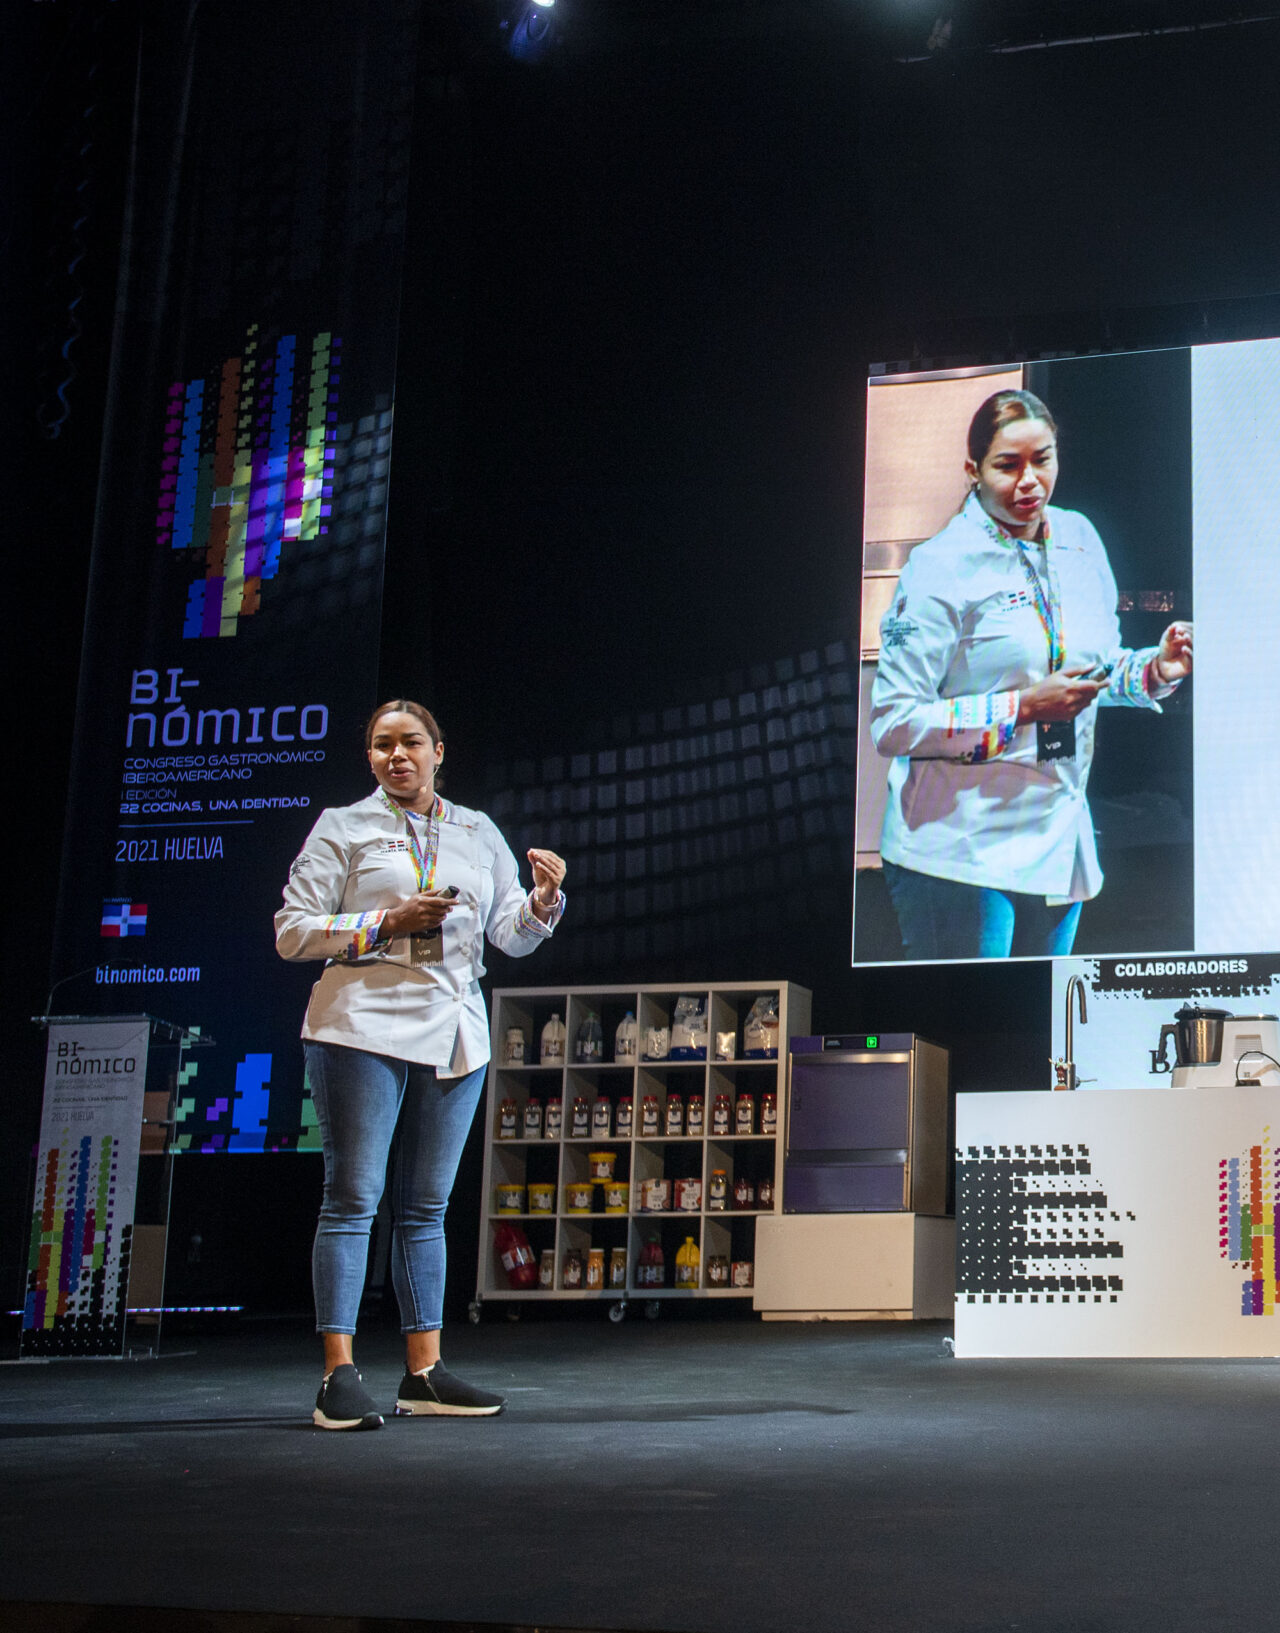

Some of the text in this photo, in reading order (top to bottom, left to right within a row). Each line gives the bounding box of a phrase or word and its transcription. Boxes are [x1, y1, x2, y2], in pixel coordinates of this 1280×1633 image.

[130, 668, 200, 705] BI-
[124, 750, 326, 770] CONGRESO GASTRONÓMICO
[123, 768, 252, 784] IBEROAMERICANO
[126, 788, 177, 801] EDICIÓN
[119, 796, 311, 814] 22 COCINAS, UNA IDENTIDAD
[115, 835, 224, 862] 2021 HUELVA
[96, 964, 200, 984] binomico.com
[1115, 959, 1249, 977] COLABORADORES
